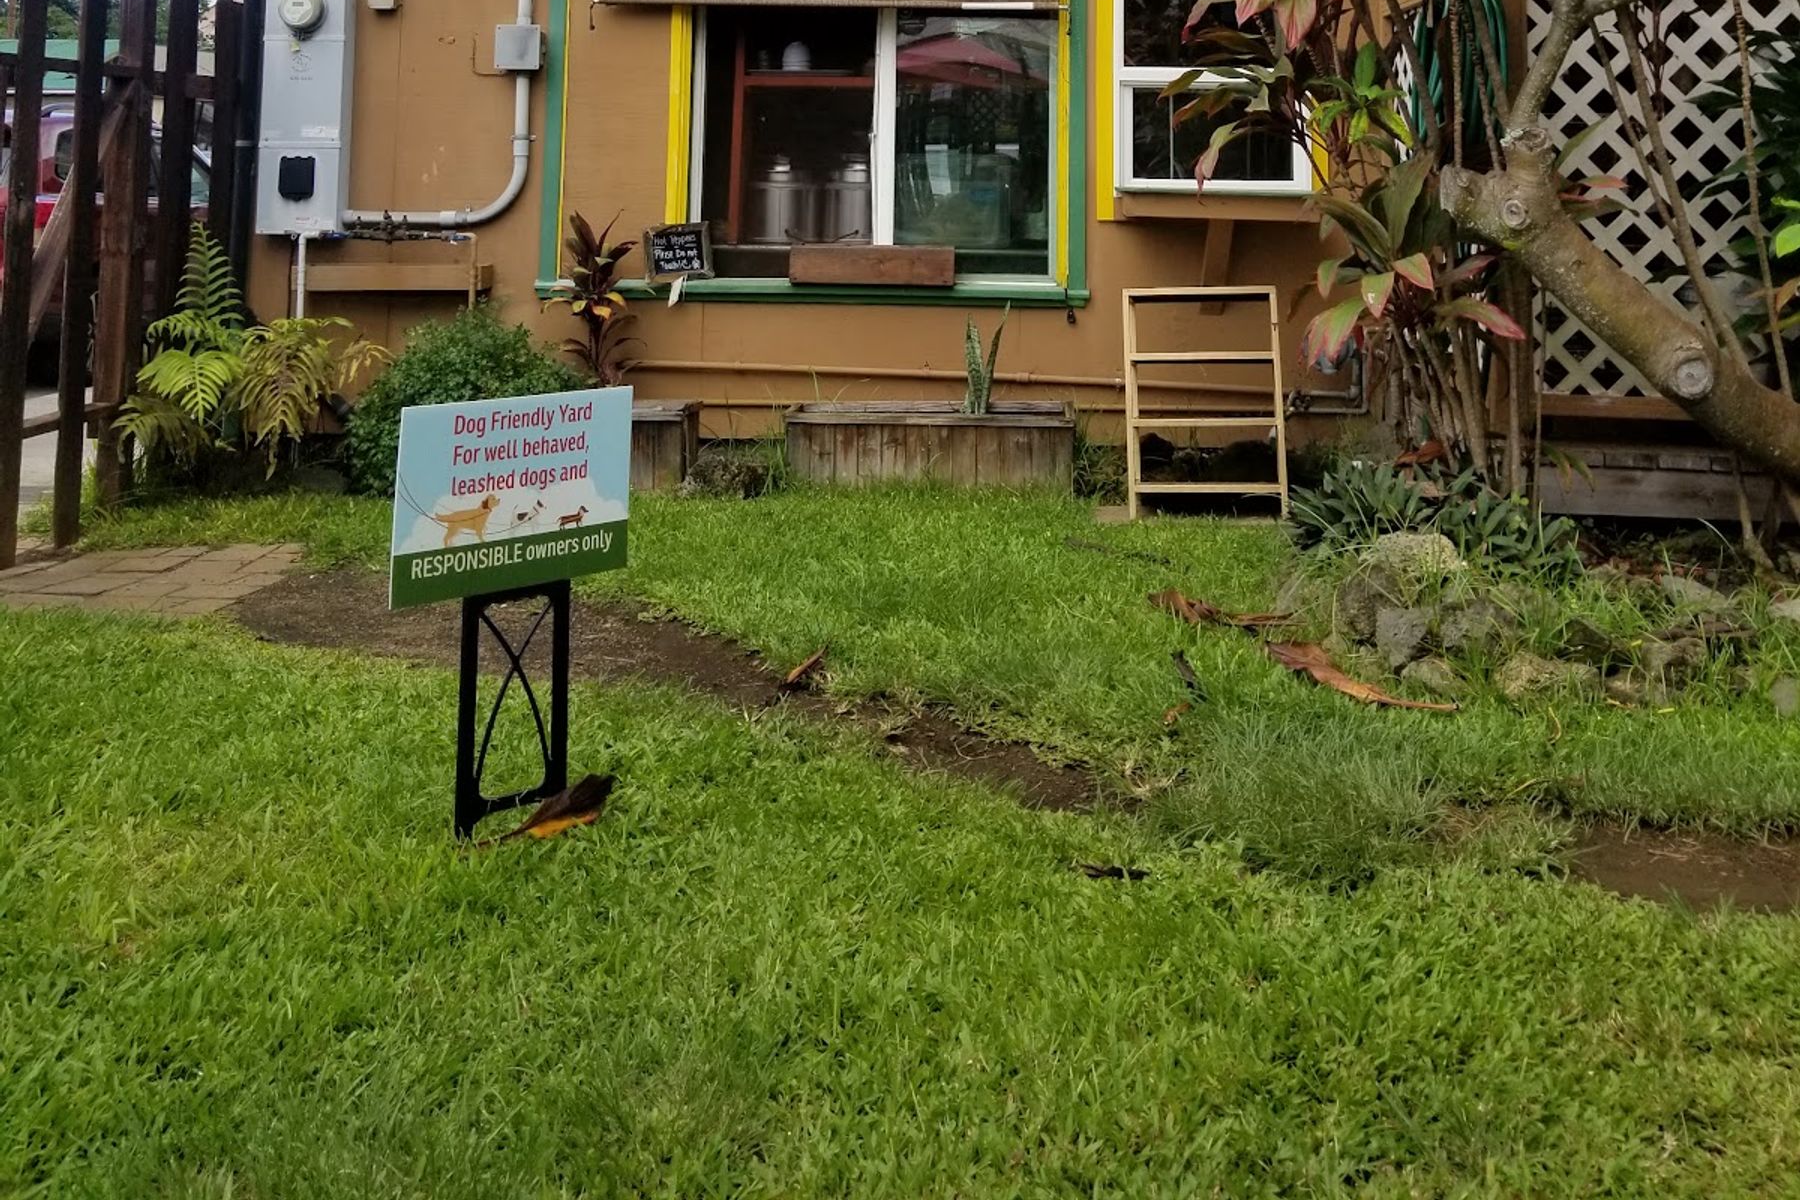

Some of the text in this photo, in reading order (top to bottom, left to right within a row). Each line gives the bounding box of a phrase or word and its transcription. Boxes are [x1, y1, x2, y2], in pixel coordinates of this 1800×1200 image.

[454, 401, 593, 439] Dog Friendly Yard
[453, 430, 590, 466] For well behaved,
[451, 459, 588, 497] leashed dogs and
[411, 529, 614, 580] RESPONSIBLE owners only
